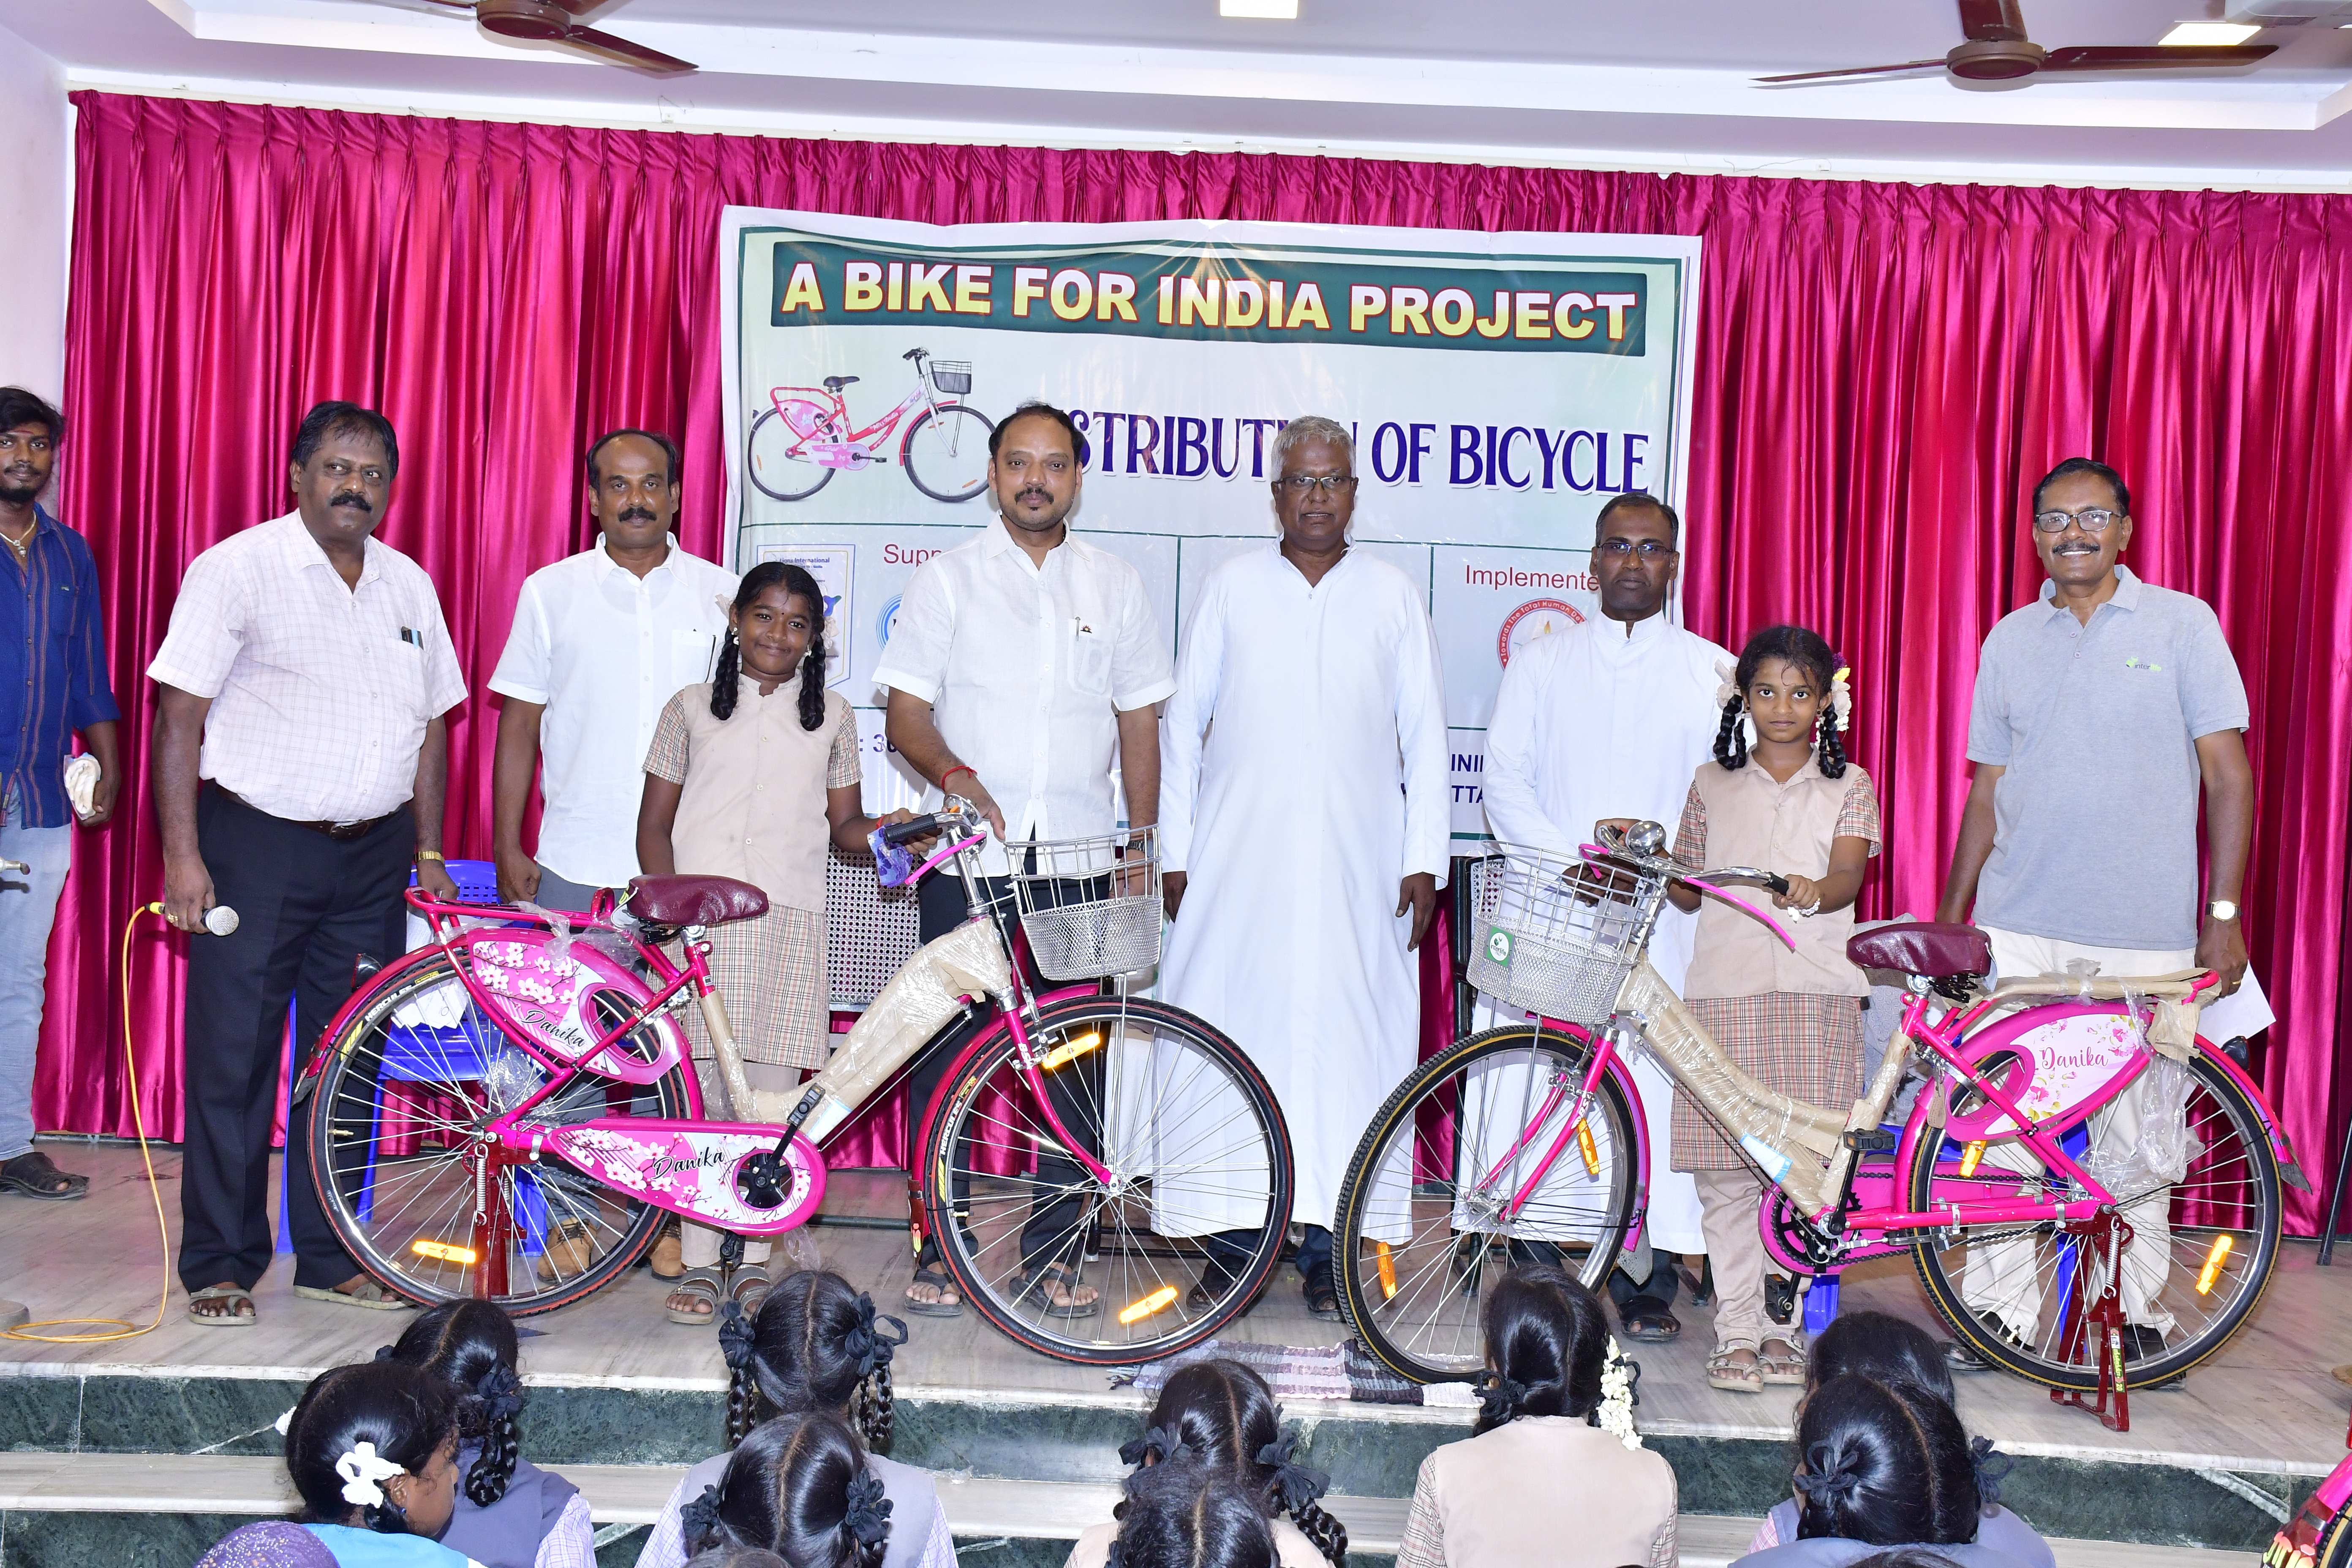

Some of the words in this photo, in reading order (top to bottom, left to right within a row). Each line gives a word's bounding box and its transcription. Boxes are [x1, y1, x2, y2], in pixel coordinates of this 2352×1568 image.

[781, 261, 826, 313] A
[844, 261, 993, 316] BIKE
[1013, 266, 1138, 322] FOR
[1158, 275, 1331, 331] INDIA
[1349, 283, 1637, 341] PROJECT
[1372, 421, 1436, 484] OF
[1449, 424, 1649, 493] BICYCLE
[1466, 564, 1600, 591] Implemente
[1521, 602, 1540, 613] Total
[1543, 601, 1571, 612] Human
[521, 1009, 586, 1048] Danika
[2039, 1046, 2109, 1070] Danika
[651, 1146, 726, 1180] Danika
[2116, 1383, 2123, 1391] 20
